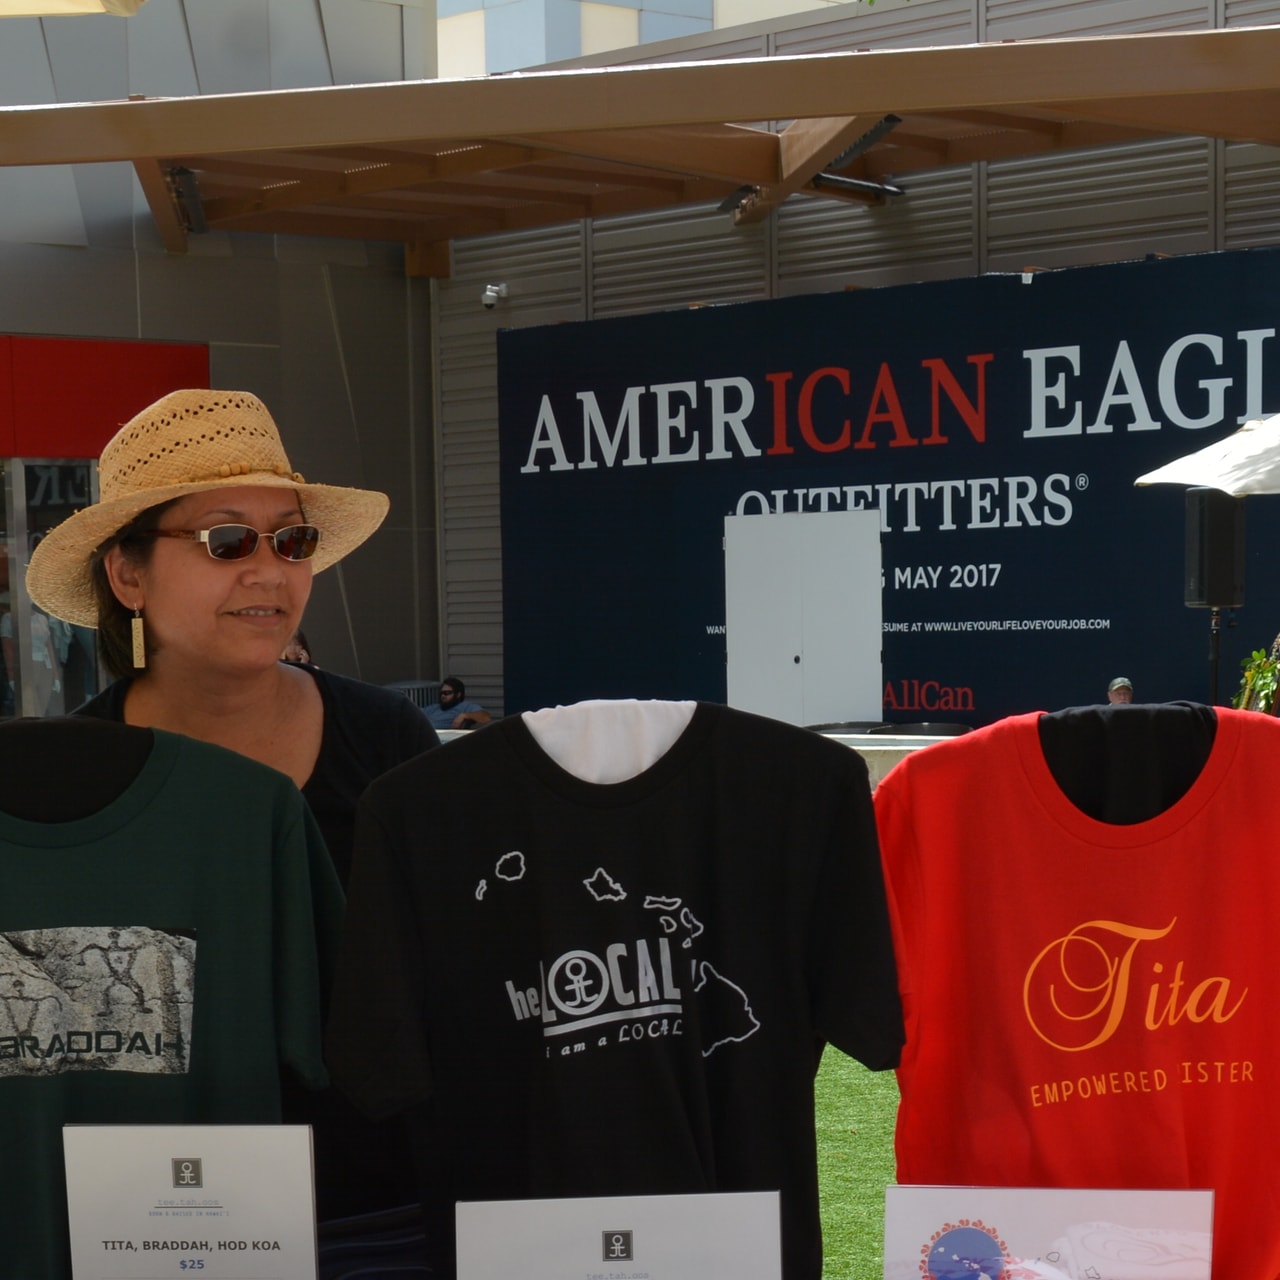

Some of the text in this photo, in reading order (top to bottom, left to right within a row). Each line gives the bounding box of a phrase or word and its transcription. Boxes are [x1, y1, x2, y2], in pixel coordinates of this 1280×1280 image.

[520, 352, 995, 474] AMERICAN
[894, 565, 943, 590] MAY
[949, 563, 1002, 588] 2017
[910, 622, 922, 632] AT
[924, 618, 1111, 632] WWW.LIVEYOURLIFELOVEYOURJOB.COM
[1022, 915, 1249, 1053] Tita
[618, 1018, 684, 1042] LOCAL
[1030, 1060, 1255, 1108] EMPOWERED ISTER
[102, 1240, 281, 1253] TITA, BRADDAH, HOD KOA
[179, 1259, 205, 1271] $25
